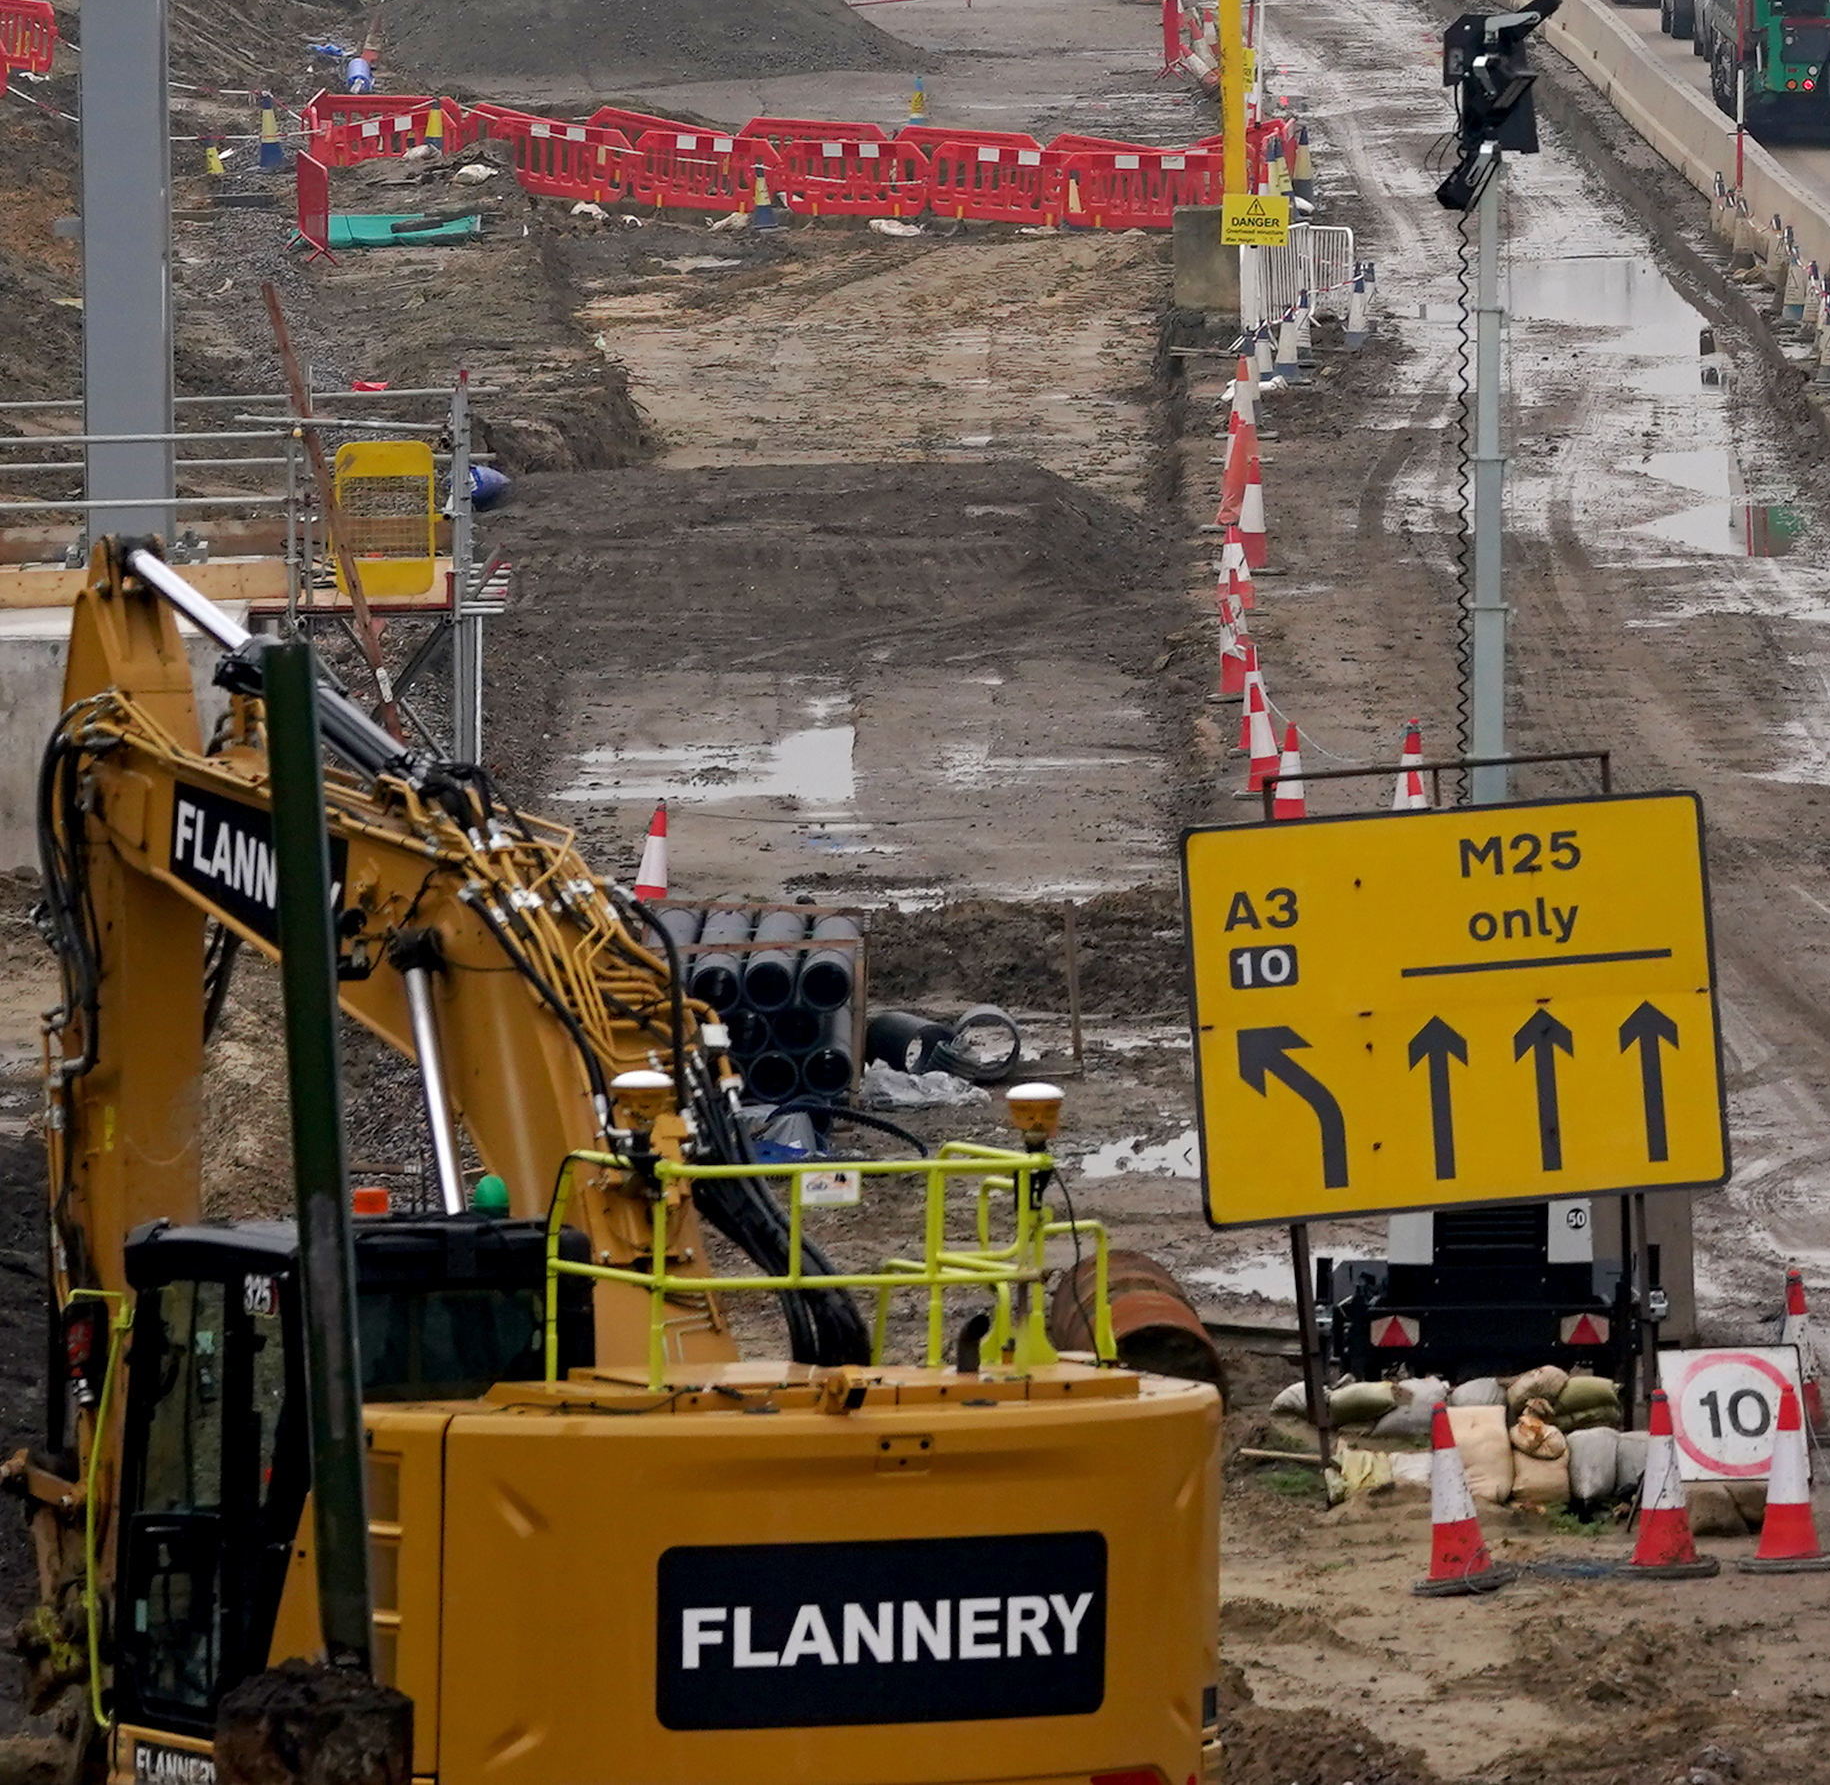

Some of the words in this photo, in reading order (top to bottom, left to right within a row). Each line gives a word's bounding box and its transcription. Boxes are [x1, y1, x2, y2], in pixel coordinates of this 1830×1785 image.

[1459, 830, 1582, 878] M25
[1224, 887, 1300, 933] A3
[1468, 896, 1580, 944] only
[1236, 948, 1292, 986] 10
[1567, 1210, 1586, 1228] 50
[244, 1272, 272, 1314] 325
[1699, 1388, 1771, 1438] 10
[681, 1590, 1095, 1670] FLANNERY
